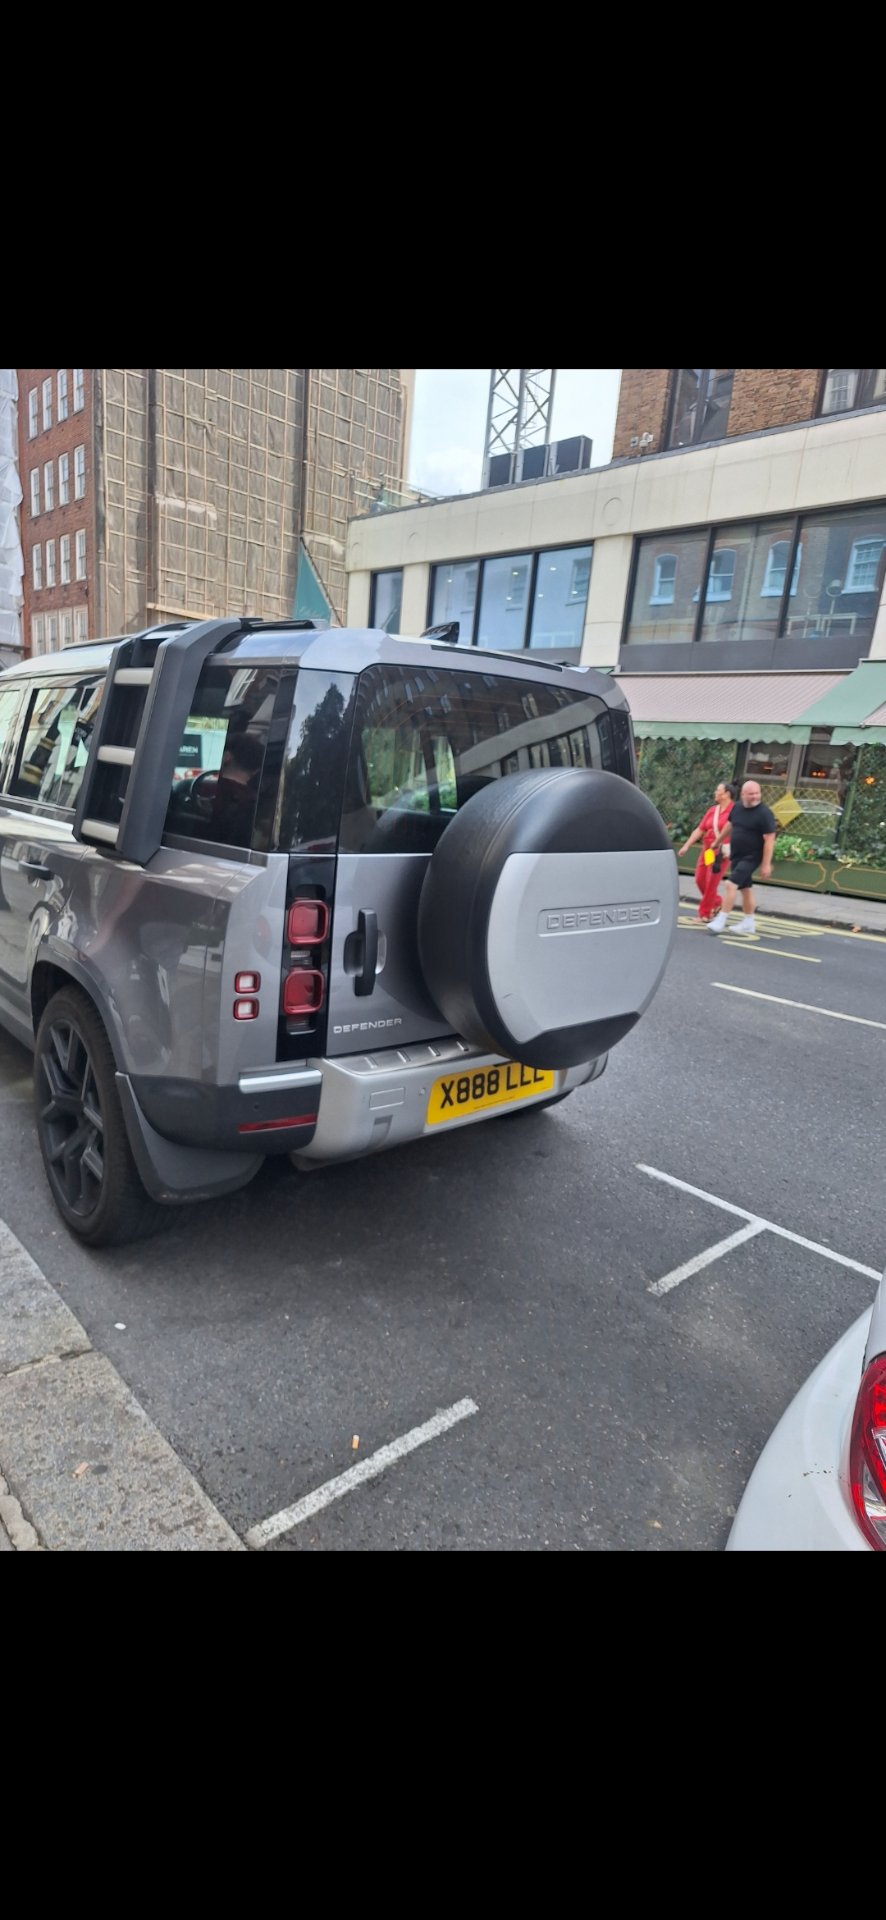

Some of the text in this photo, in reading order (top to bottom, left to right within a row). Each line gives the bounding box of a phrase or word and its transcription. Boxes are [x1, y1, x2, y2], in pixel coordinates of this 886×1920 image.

[547, 906, 651, 930] DEFENDER
[333, 1018, 402, 1034] DEFENDER
[440, 1069, 500, 1109] X888
[506, 1065, 544, 1091] LLL
